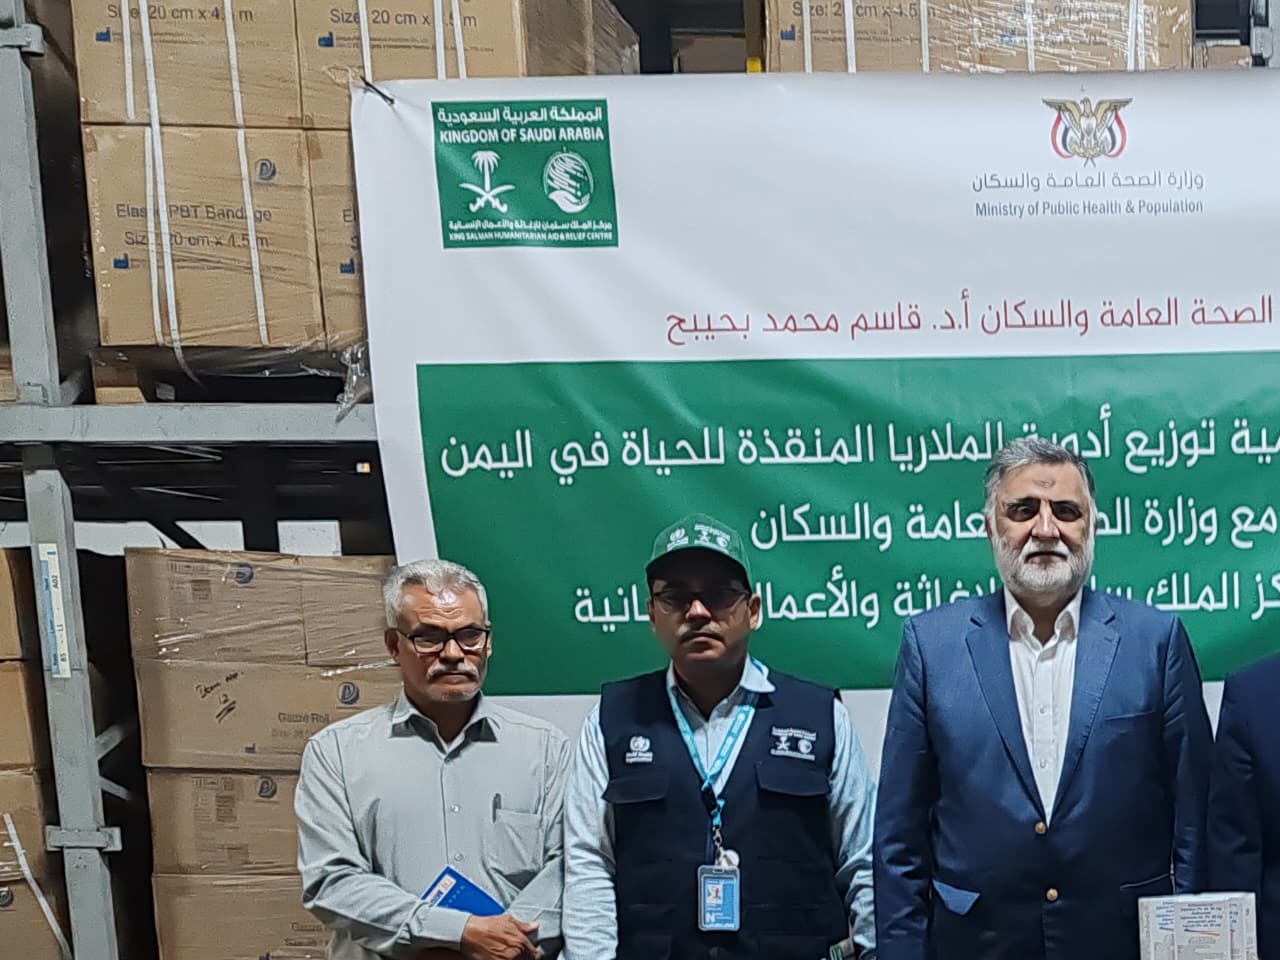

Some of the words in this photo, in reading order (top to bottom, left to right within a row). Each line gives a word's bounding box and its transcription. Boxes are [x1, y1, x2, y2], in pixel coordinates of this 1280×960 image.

[438, 108, 500, 127] السعودية
[503, 107, 547, 125] العربية
[550, 106, 602, 122] المملكة
[440, 130, 498, 143] KINGDOM
[502, 129, 517, 142] OF
[520, 128, 556, 142] SAUDI
[559, 127, 604, 141] ARABIA
[972, 173, 1040, 192] والسكان
[1046, 172, 1106, 189] العامة
[1111, 171, 1162, 188] الصحة
[1168, 172, 1204, 190] وزارة
[975, 201, 1025, 218] Ministry
[1028, 201, 1039, 216] of
[1043, 200, 1079, 215] Public
[1083, 200, 1121, 214] Health
[1125, 200, 1135, 214] &
[1138, 199, 1204, 216] Population
[762, 316, 840, 334] محمد
[851, 302, 922, 341] قاسم
[981, 299, 1089, 336] والسكان
[1100, 297, 1178, 327] العامة
[1191, 294, 1272, 327] الصحة
[665, 314, 752, 345] بحيبح
[441, 430, 533, 479] اليمن
[550, 430, 609, 486] في
[621, 426, 726, 476] للحياة
[738, 425, 875, 465] المنقذة
[888, 422, 1003, 473] الملاريا
[1124, 417, 1217, 474] توزيع
[750, 502, 892, 551] والسكان
[1144, 497, 1218, 545] وزارة
[1231, 506, 1277, 549] مع
[1147, 571, 1240, 610] الملك
